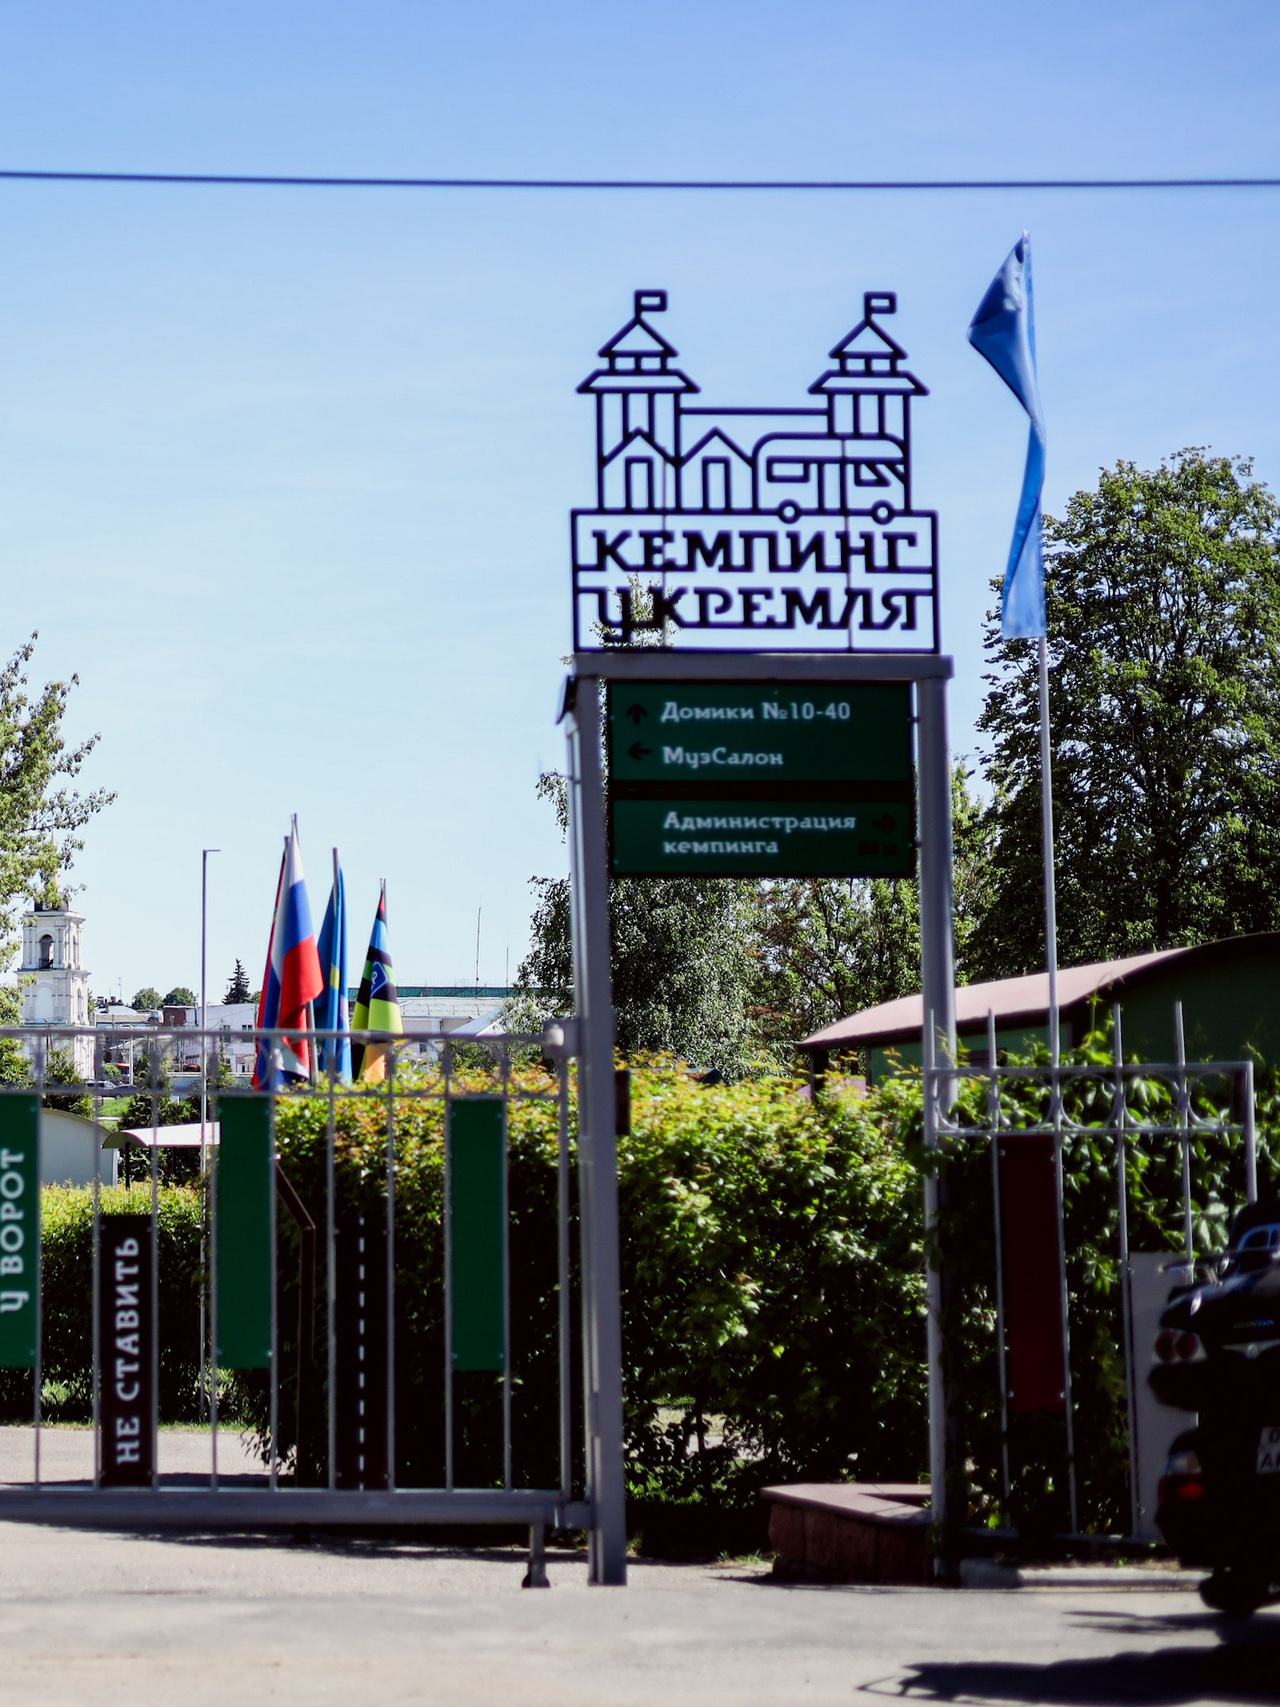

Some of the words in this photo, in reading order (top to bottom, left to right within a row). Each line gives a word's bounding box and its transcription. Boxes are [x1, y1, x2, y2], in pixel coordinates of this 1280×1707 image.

[592, 530, 918, 573] КЕМПИНГ
[594, 586, 634, 643] У
[646, 586, 918, 630] КРЕМЛЯ
[661, 701, 755, 724] Домики
[762, 701, 851, 720] №10-40
[662, 746, 784, 769] МузСалон
[663, 811, 857, 833] Администрация
[663, 840, 779, 854] кемпинга
[0, 1148, 25, 1276] ВОРОТ
[0, 1290, 29, 1313] У
[114, 1237, 140, 1402] СТАВИТЬ
[116, 1416, 140, 1465] НЕ
